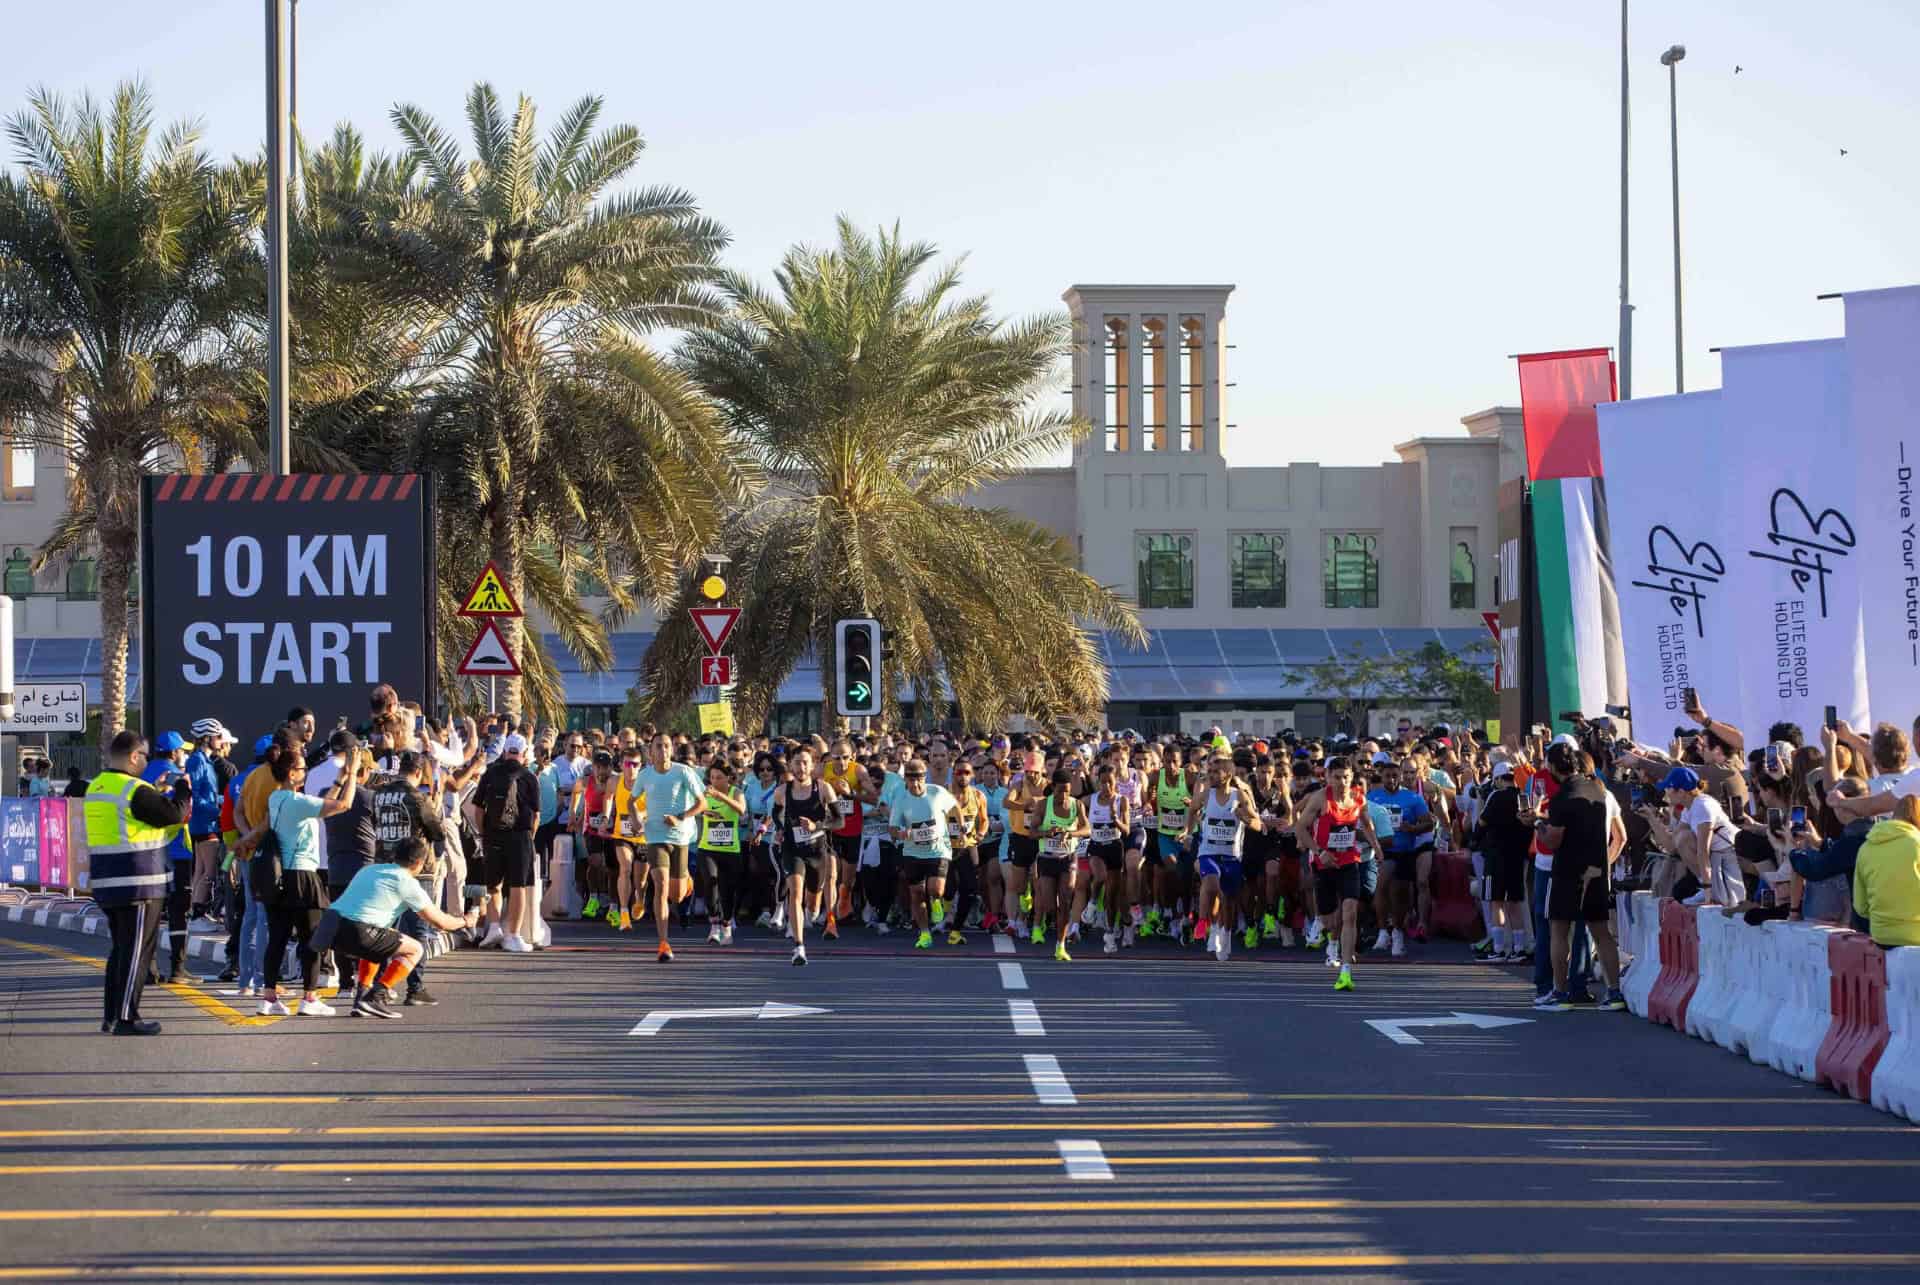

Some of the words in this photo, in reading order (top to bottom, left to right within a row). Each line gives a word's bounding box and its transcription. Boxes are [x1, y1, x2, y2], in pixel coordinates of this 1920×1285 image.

[1898, 467, 1912, 519] Drive
[186, 535, 263, 597] 10
[287, 534, 387, 597] KM
[1901, 523, 1915, 570] Your
[1791, 600, 1806, 643] ELITE
[1905, 576, 1919, 641] Future
[182, 621, 392, 685] START
[1657, 625, 1675, 682] HOLDING
[1671, 623, 1687, 661] ELITE
[1775, 601, 1791, 668] HOLDING
[1778, 671, 1792, 700] LTD
[1793, 646, 1808, 698] GROUP
[14, 712, 58, 725] Suqeim
[65, 712, 80, 723] St
[42, 687, 80, 708] شارع
[1663, 684, 1678, 711] LTD
